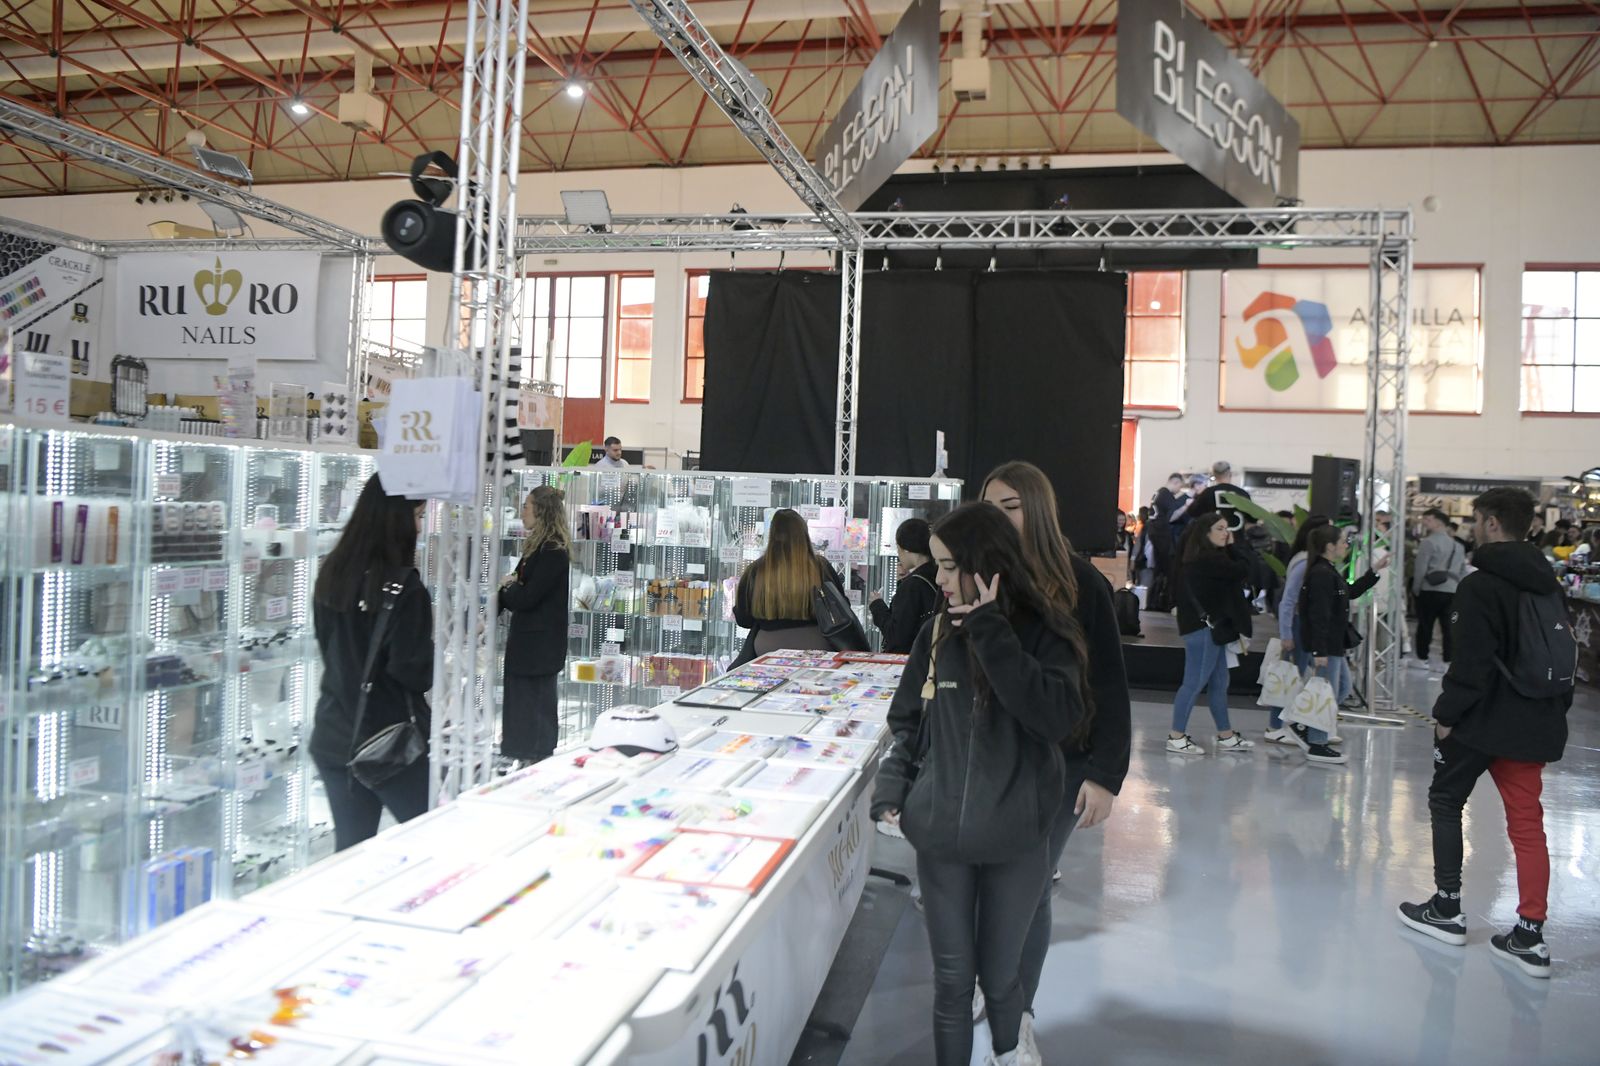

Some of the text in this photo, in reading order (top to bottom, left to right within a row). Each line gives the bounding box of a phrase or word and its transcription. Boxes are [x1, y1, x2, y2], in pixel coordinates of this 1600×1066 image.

[139, 282, 298, 316] RU RO
[181, 325, 257, 345] NAILS
[25, 397, 65, 416] 15 €
